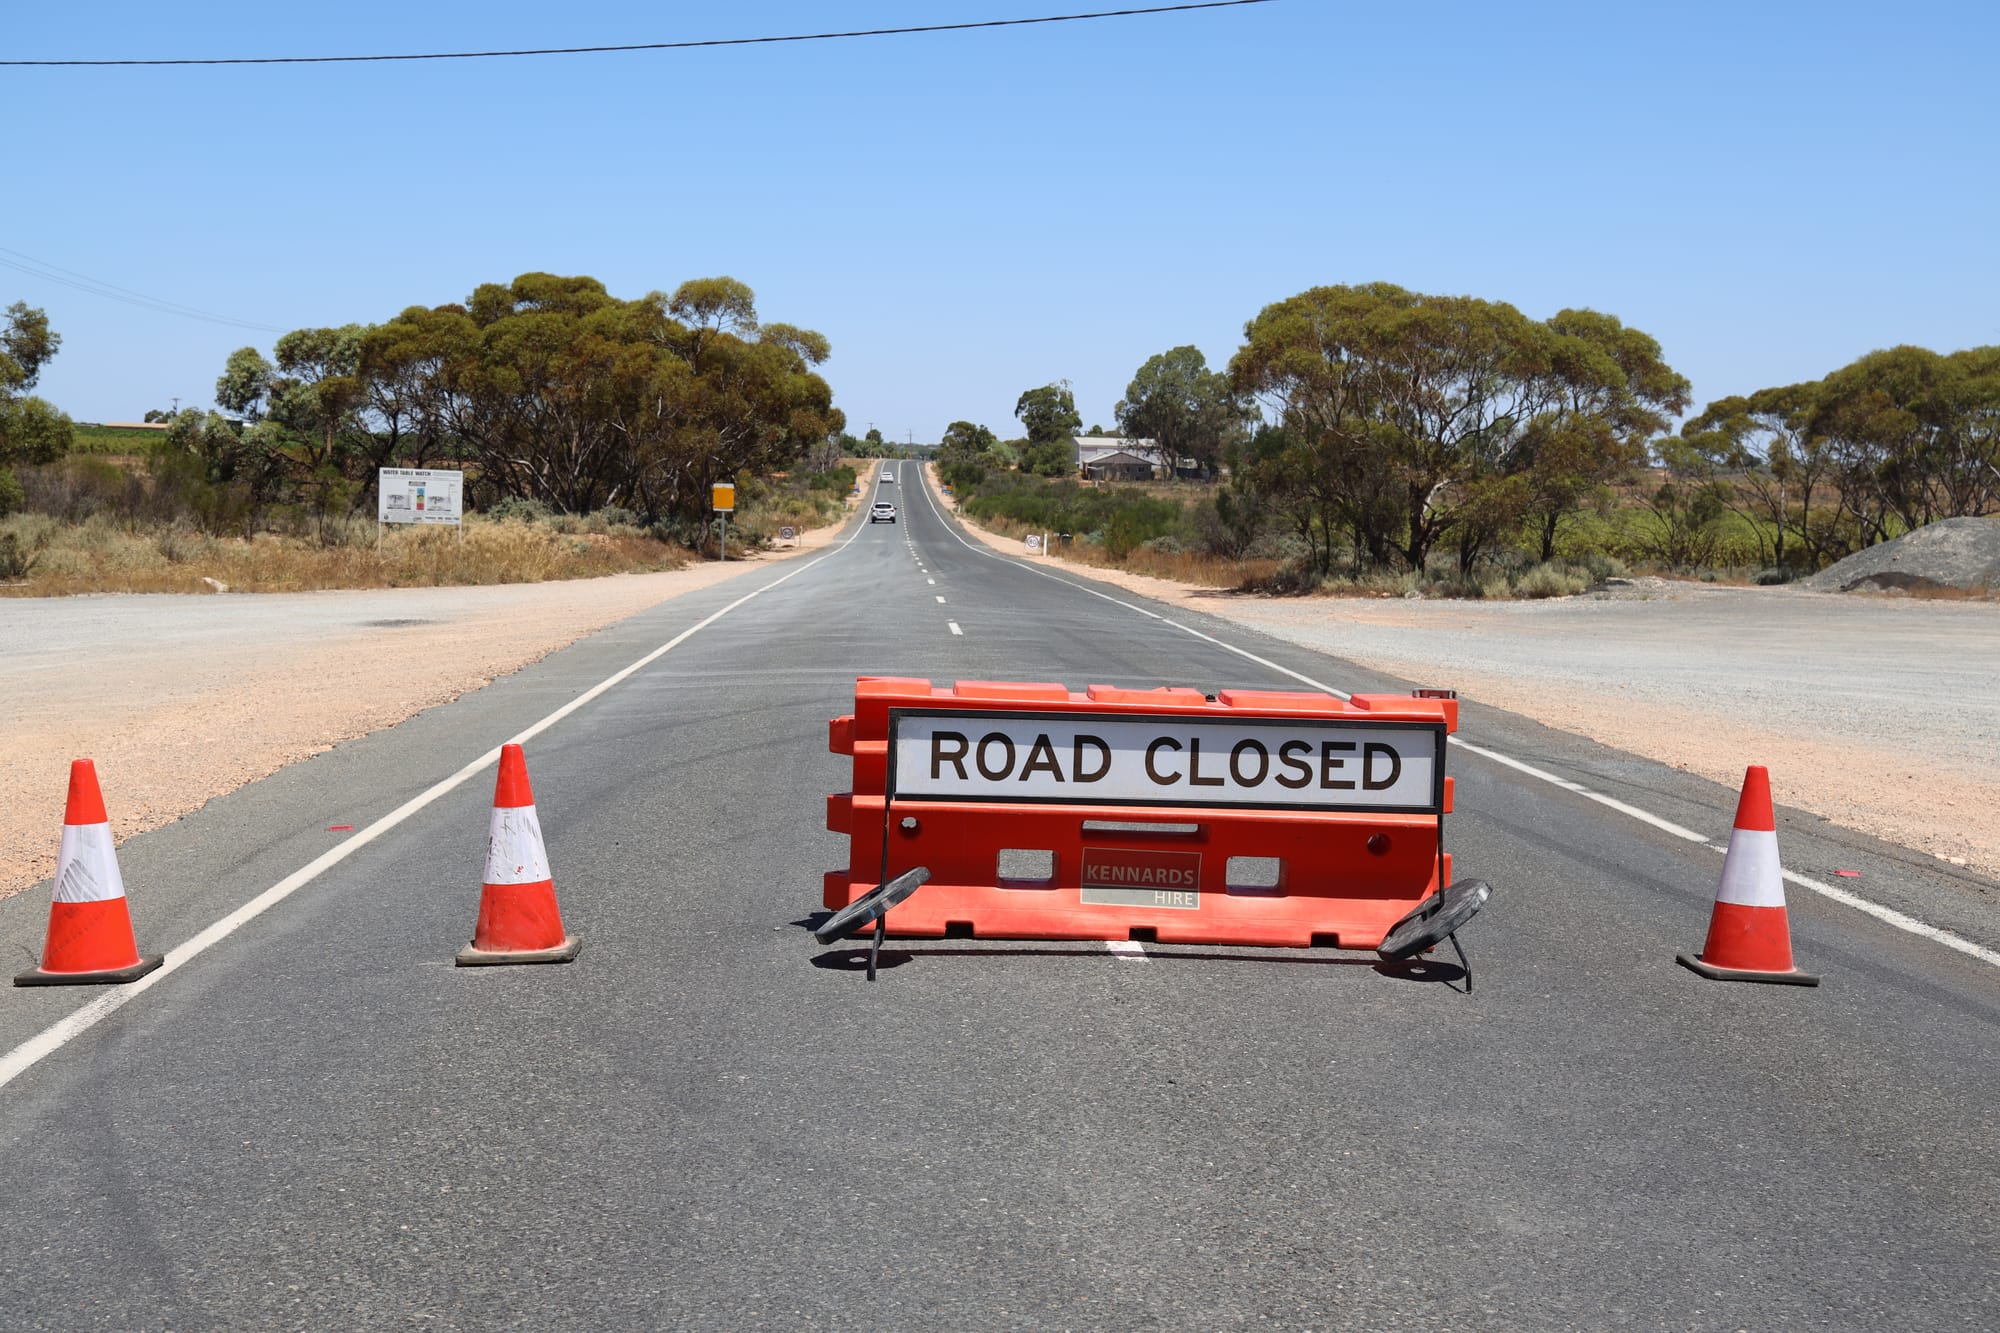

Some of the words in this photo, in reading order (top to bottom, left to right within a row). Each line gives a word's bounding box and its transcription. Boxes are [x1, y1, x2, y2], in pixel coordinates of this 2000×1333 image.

[931, 731, 1112, 783] ROAD
[1145, 736, 1401, 790] CLOSED
[1087, 865, 1194, 885] KENNARDS
[1154, 890, 1193, 906] HIRE
